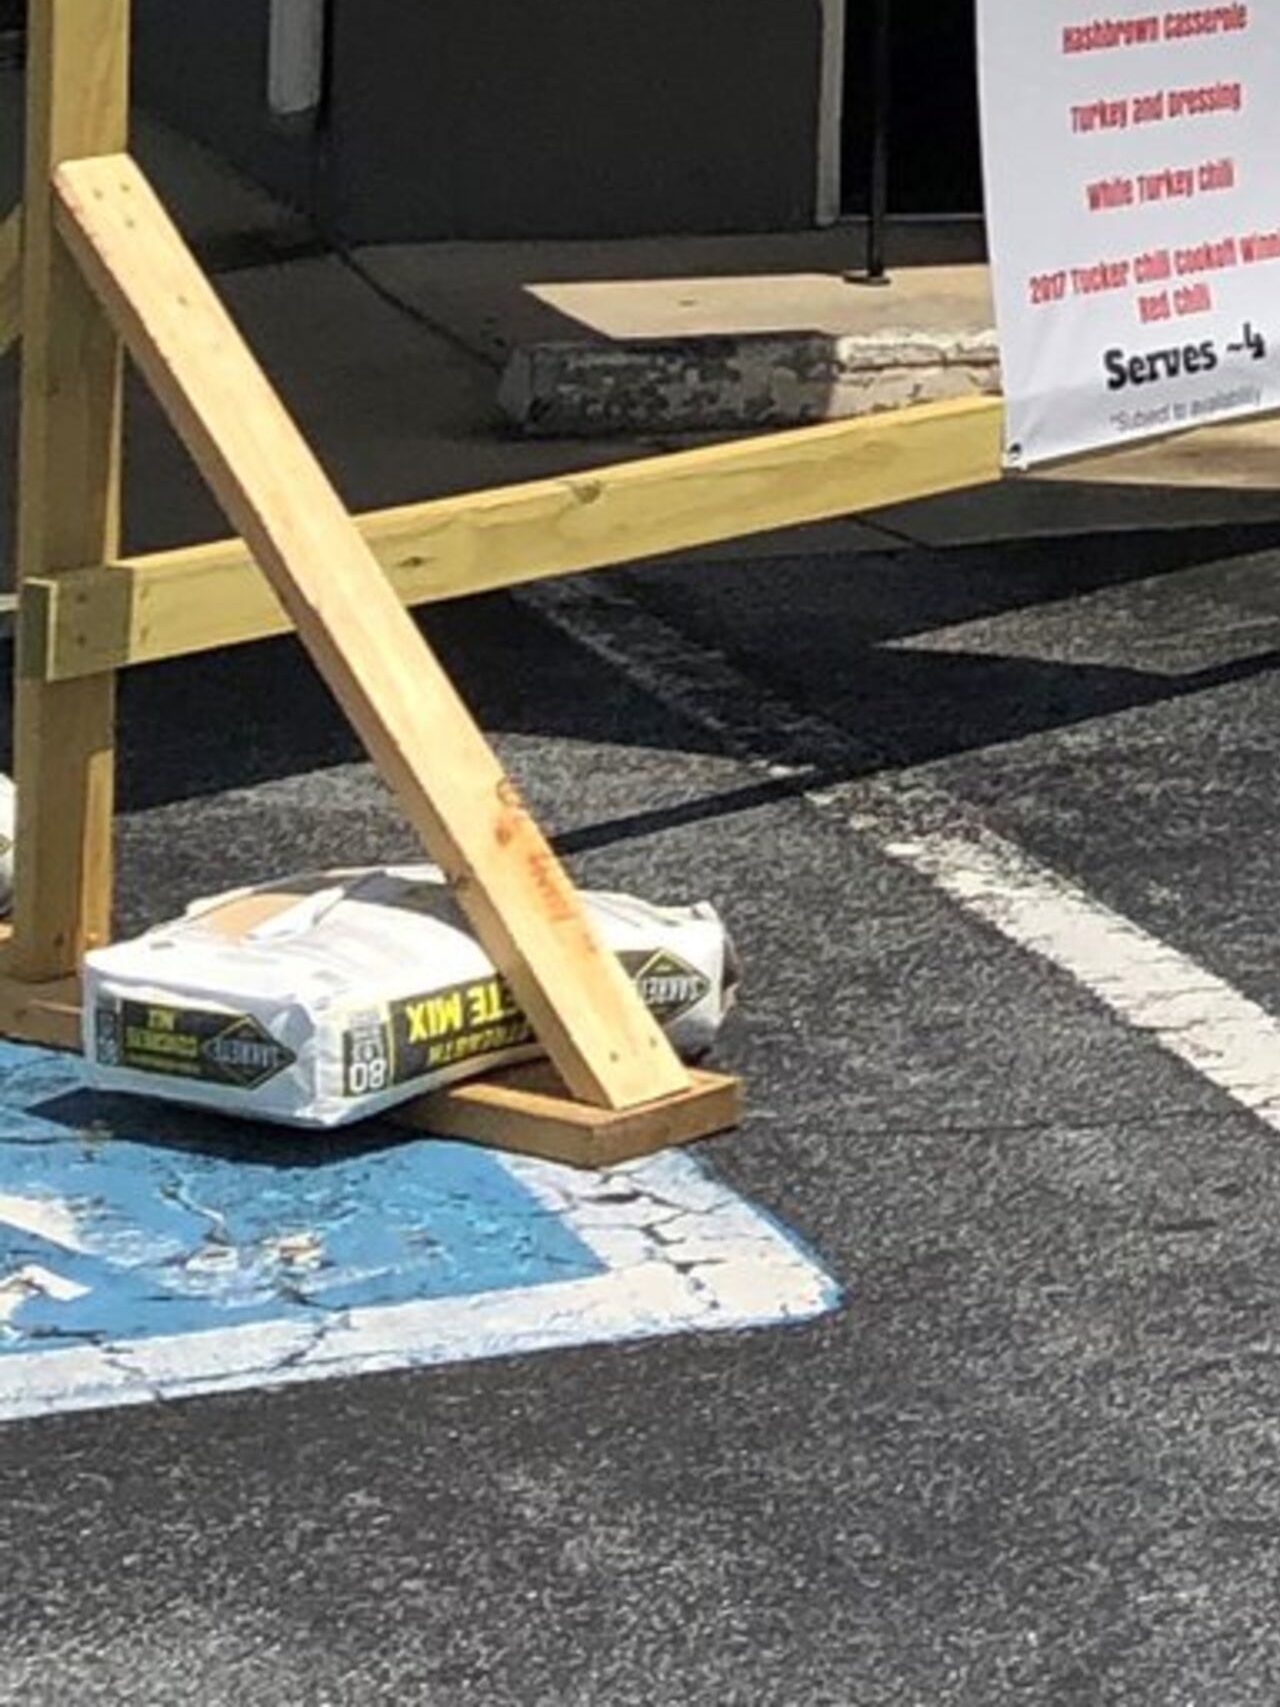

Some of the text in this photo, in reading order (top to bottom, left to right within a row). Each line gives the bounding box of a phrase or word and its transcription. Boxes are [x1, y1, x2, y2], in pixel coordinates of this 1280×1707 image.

[1071, 99, 1127, 133] Turkey
[1133, 91, 1163, 124] and
[1137, 167, 1194, 203] Turkey
[1103, 340, 1218, 392] Serves
[406, 991, 463, 1043] MIX
[350, 1058, 387, 1093] 80
